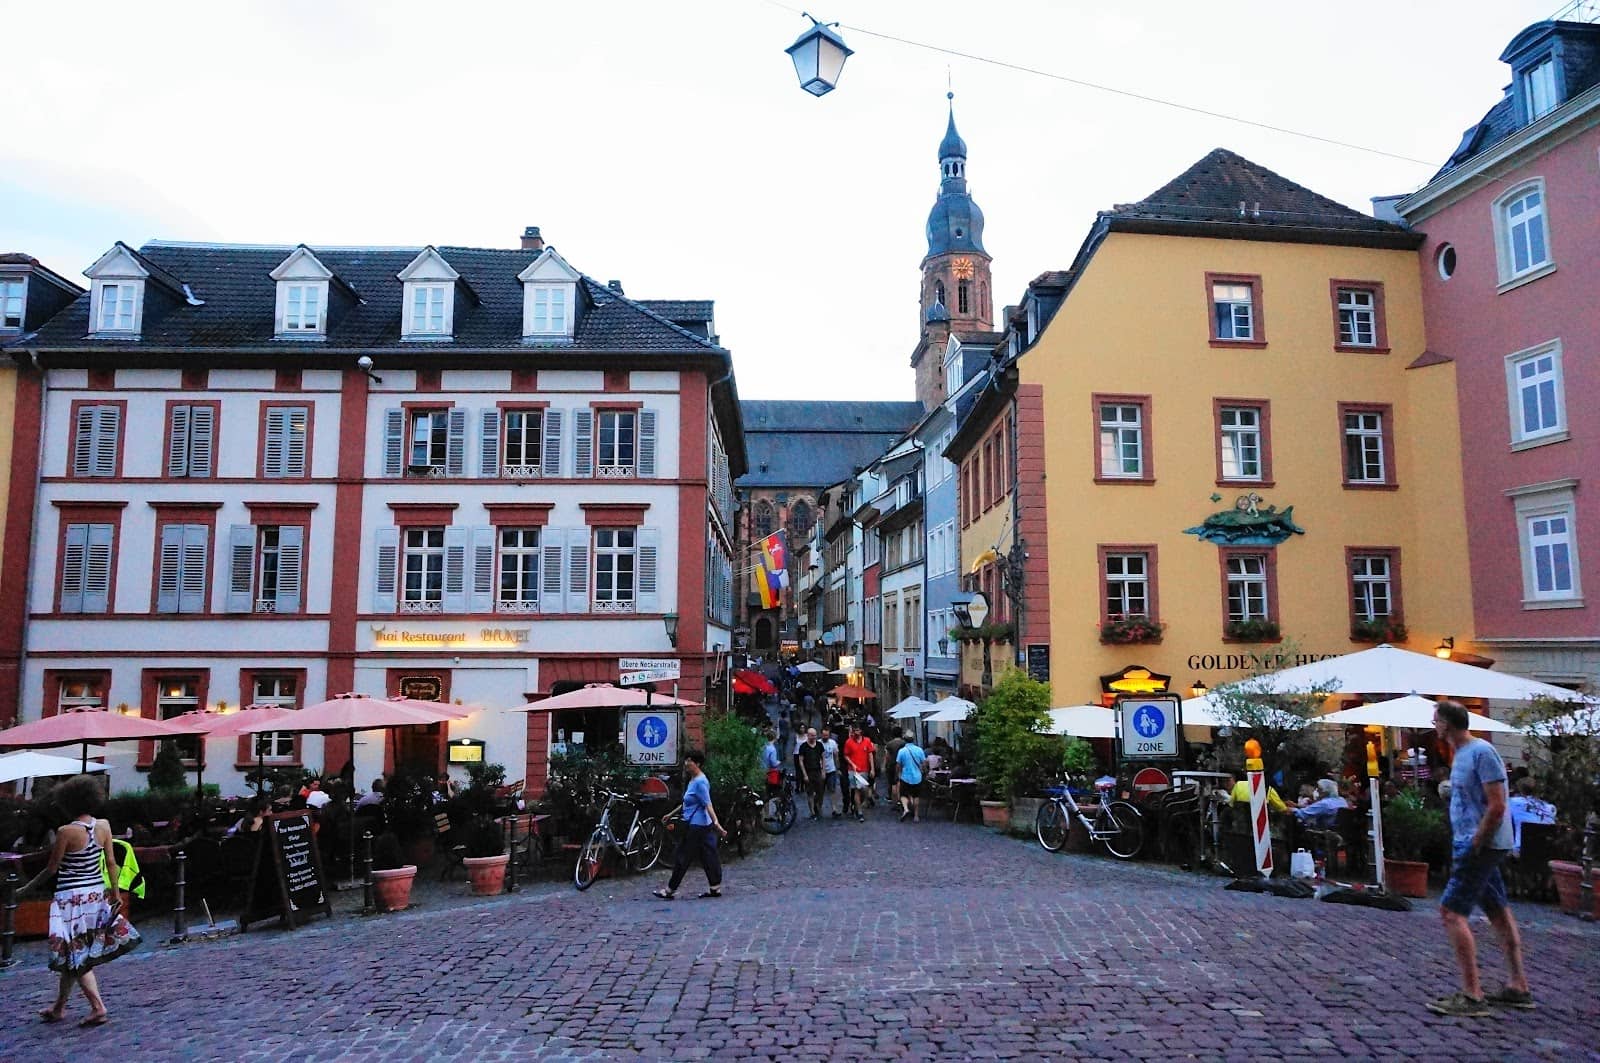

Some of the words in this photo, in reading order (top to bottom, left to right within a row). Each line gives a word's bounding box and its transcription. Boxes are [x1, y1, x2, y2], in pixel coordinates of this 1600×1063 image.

[402, 630, 466, 643] Restaurant
[621, 660, 639, 668] Obere
[640, 661, 678, 669] Neckarstraße
[1136, 742, 1164, 752] ZONE
[639, 752, 665, 762] ZONE
